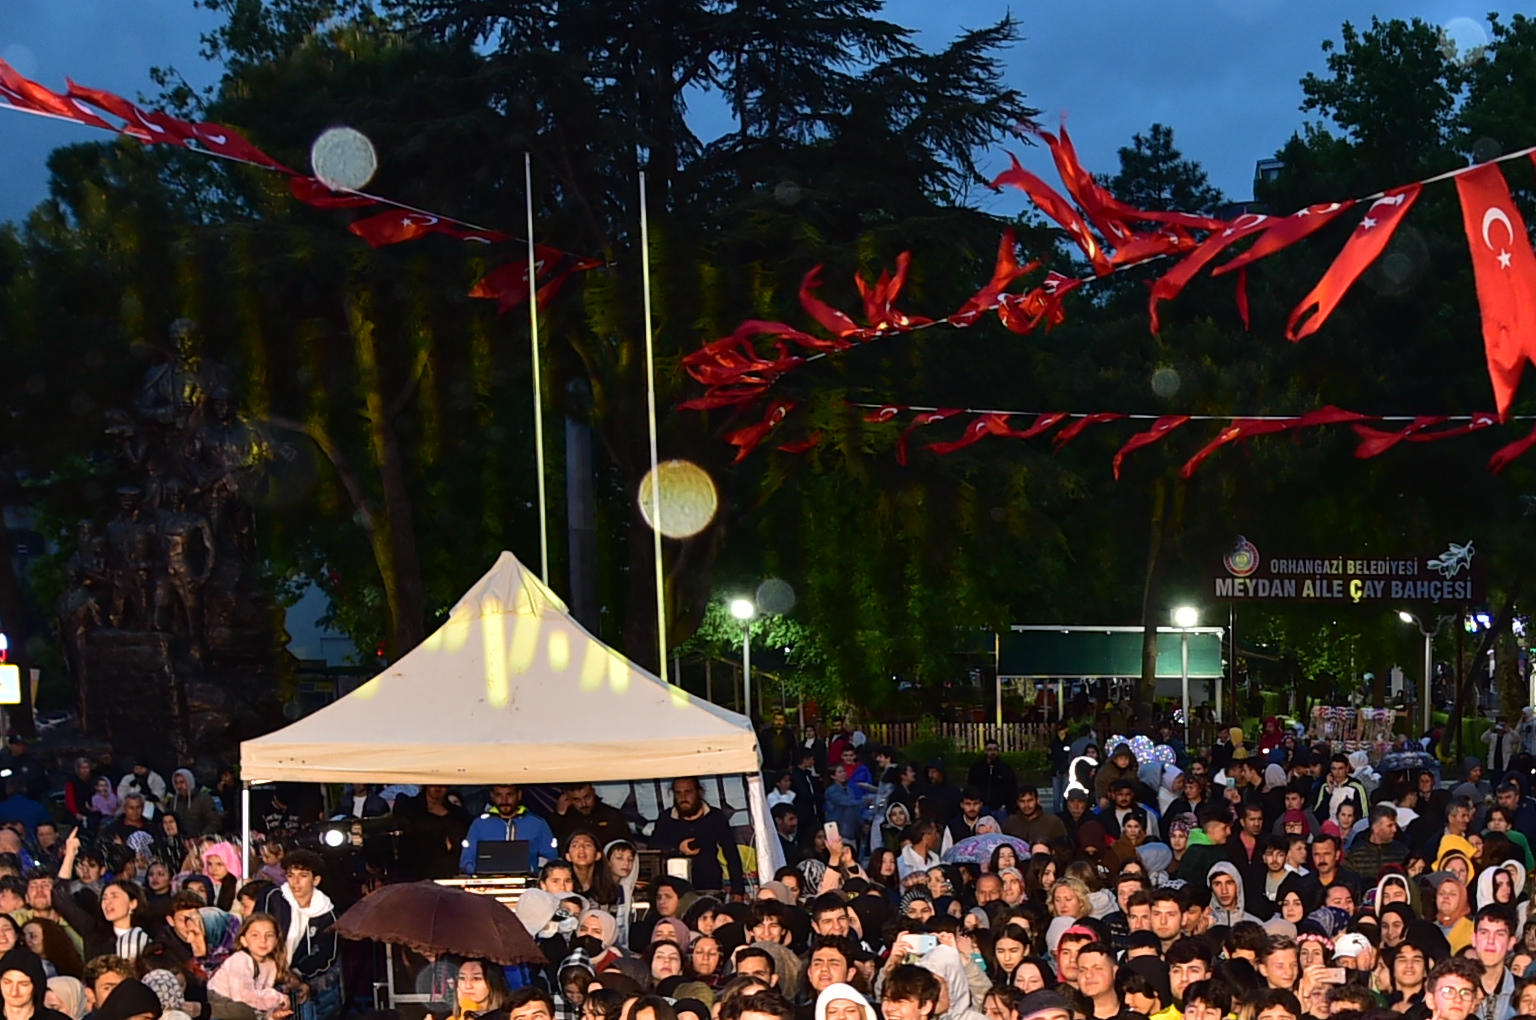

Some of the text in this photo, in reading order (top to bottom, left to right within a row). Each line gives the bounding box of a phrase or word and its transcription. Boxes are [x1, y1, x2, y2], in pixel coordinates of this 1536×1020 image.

[1270, 556, 1418, 575] ORHANGAZİ BELEDİYESİ
[1215, 574, 1473, 603] MEYDAN AİLE ÇAY BAHÇESİ
